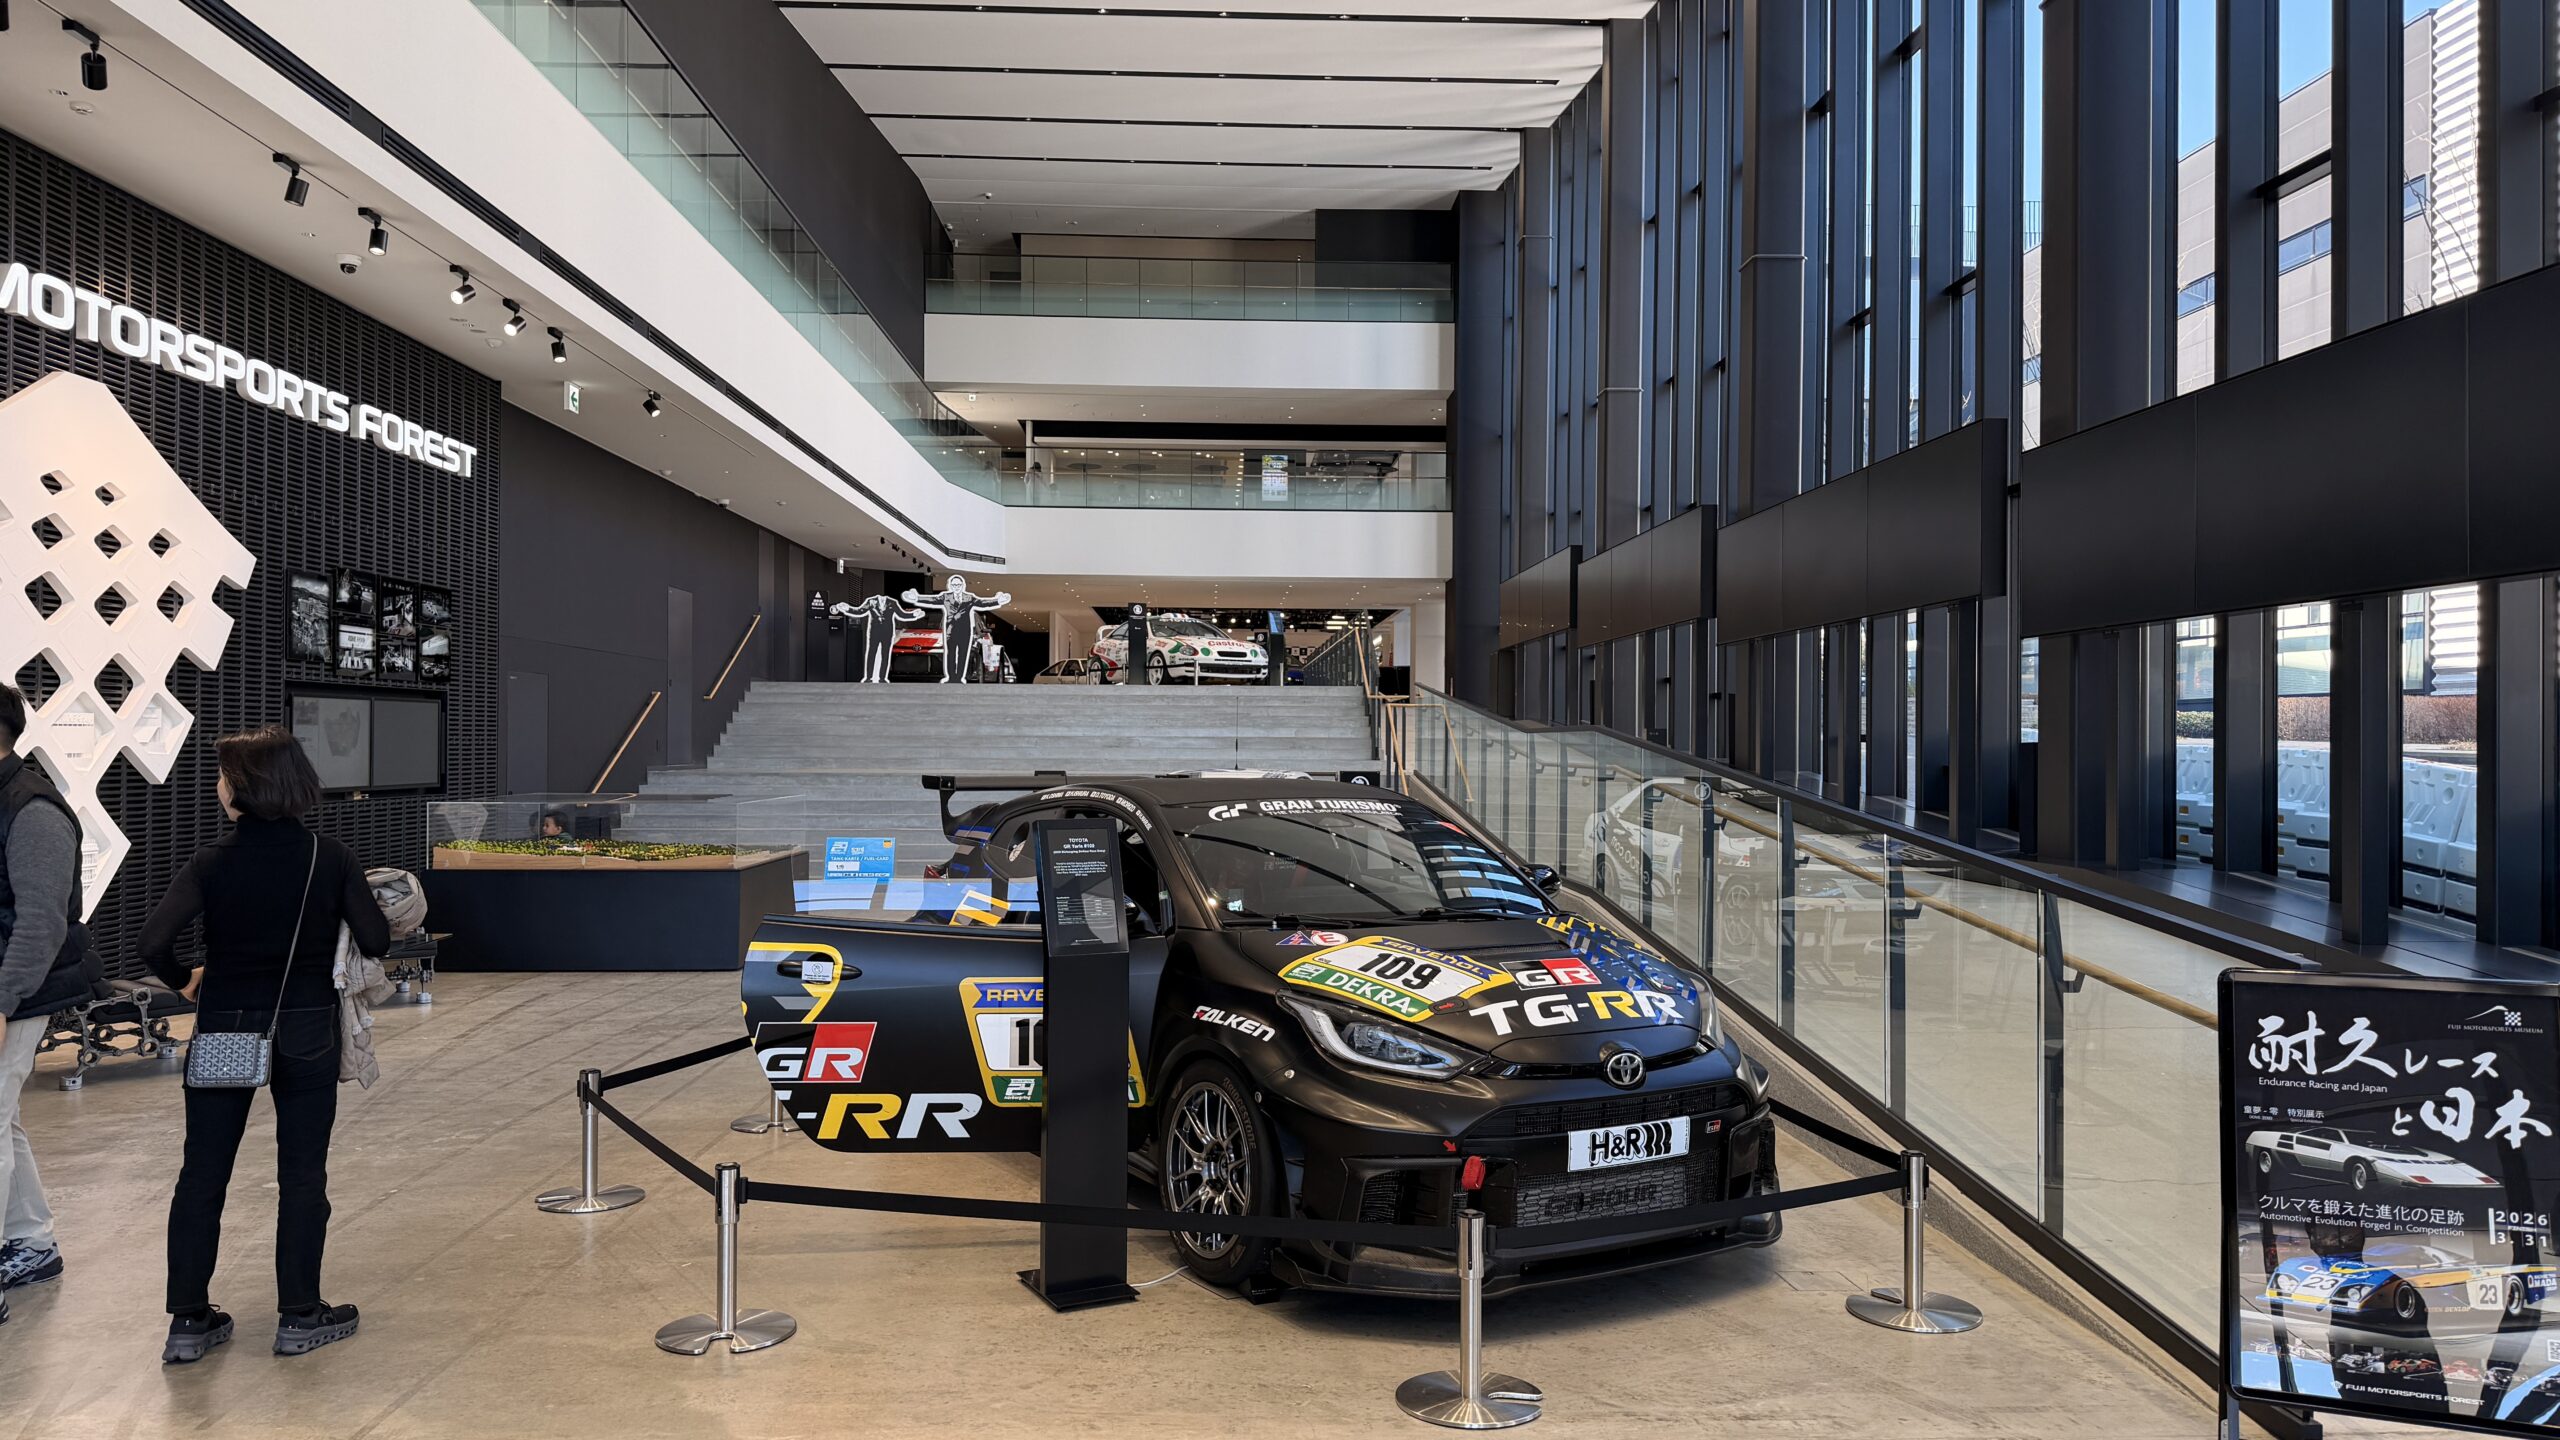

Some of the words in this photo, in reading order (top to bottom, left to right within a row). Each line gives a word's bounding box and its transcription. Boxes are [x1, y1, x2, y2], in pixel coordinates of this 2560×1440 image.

[351, 404, 477, 478] FOREST
[1259, 800, 1314, 812] GRAN
[1315, 800, 1398, 812] TURISMO
[1357, 952, 1442, 990] 109
[1383, 940, 1486, 976] RAVENOL
[1515, 967, 1595, 986] GR
[1325, 972, 1412, 1015] DEKRA
[1192, 1005, 1276, 1042] FALKEN
[1469, 990, 1685, 1036] TG-RR
[2249, 1010, 2499, 1078] 耐久レース
[757, 1047, 865, 1079] GR
[2258, 1077, 2307, 1088] Endurance
[2308, 1080, 2339, 1092] Racing
[2341, 1082, 2360, 1091] and
[2361, 1083, 2388, 1094] Japan
[2287, 1108, 2325, 1119] 特別展示
[2392, 1086, 2553, 1149] と日本
[1590, 1127, 1642, 1165] H&R
[2259, 1194, 2465, 1226] クルマを鍛えた進化の足跡
[2260, 1211, 2312, 1223] Automotive
[2315, 1216, 2357, 1227] Evolution
[2360, 1219, 2391, 1231] Forged
[2394, 1223, 2403, 1231] in
[2405, 1223, 2465, 1237] Competition
[2495, 1210, 2548, 1226] 2026
[2302, 1276, 2340, 1290] 23
[2479, 1284, 2498, 1304] 23
[2367, 1387, 2442, 1401] MOTORSPORTS
[2444, 1396, 2485, 1406] FOREST
